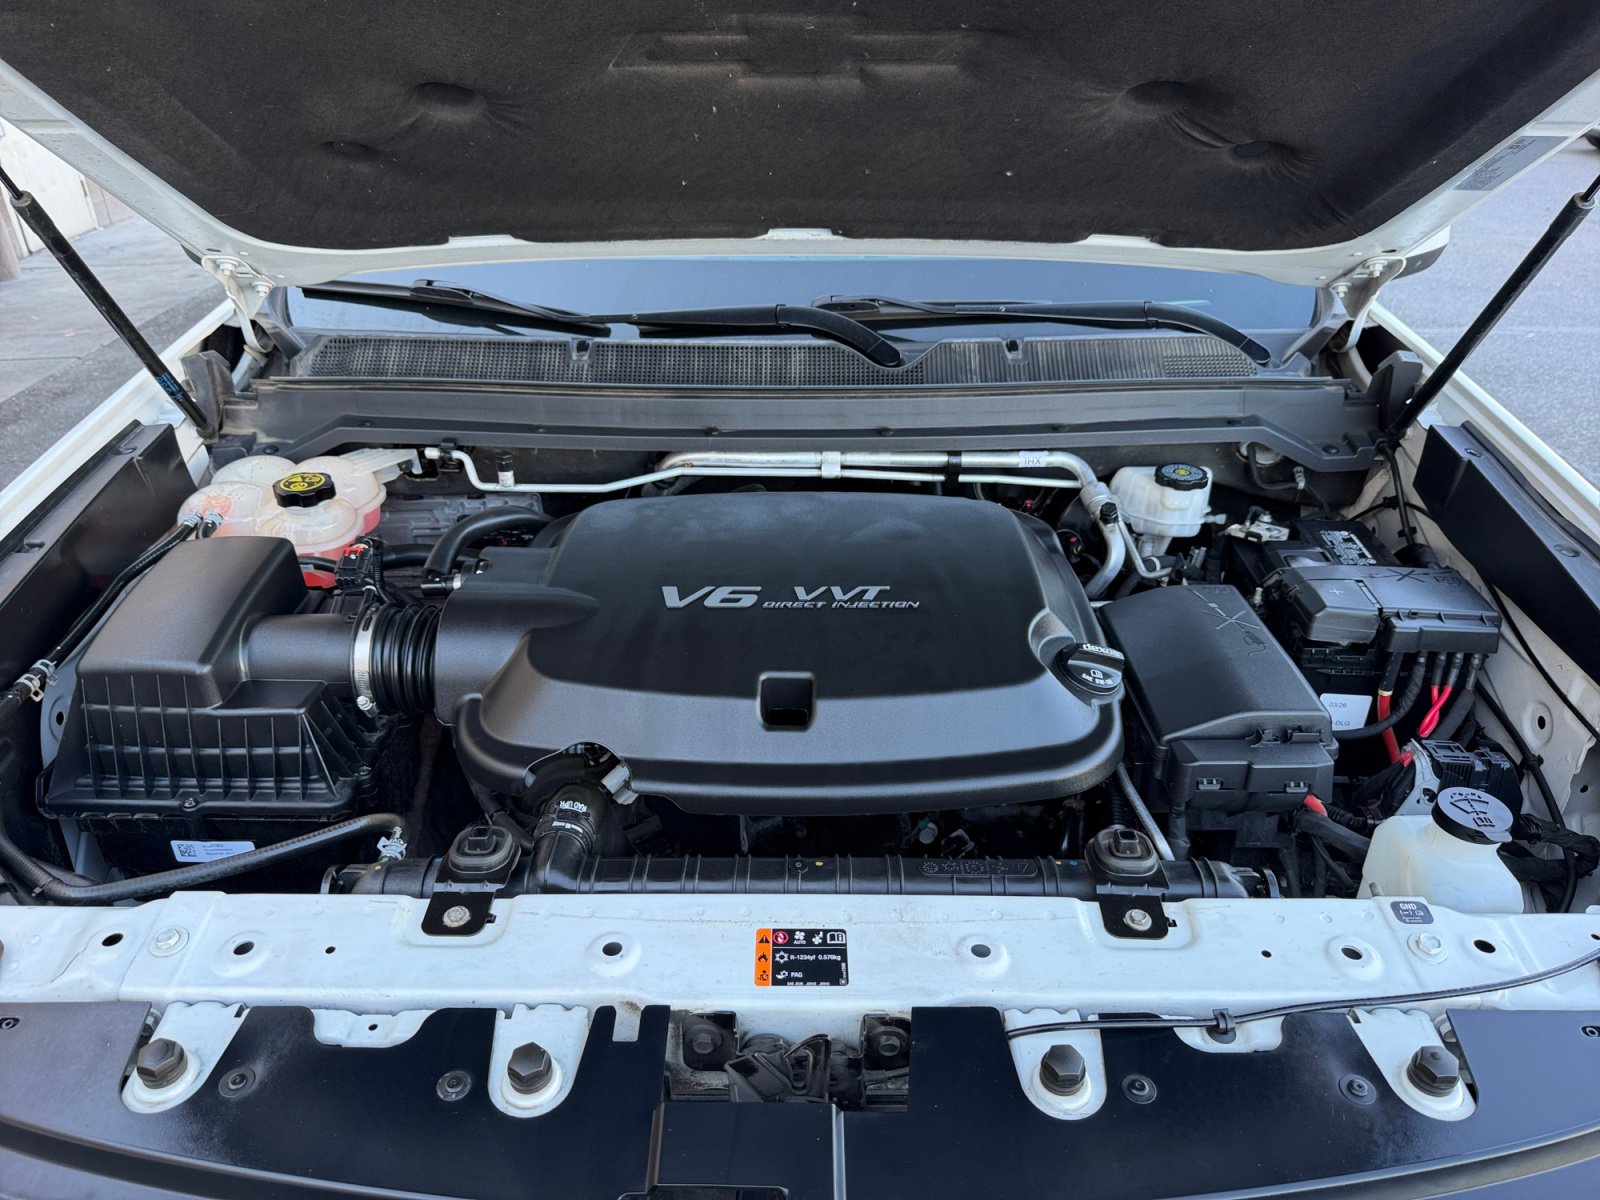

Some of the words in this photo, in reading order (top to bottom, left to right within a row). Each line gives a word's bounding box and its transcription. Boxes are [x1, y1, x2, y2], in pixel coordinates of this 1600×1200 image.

[661, 585, 762, 608] V6
[793, 585, 891, 601] VVT
[762, 601, 827, 609] DIRECT
[831, 601, 920, 609] INJECTION
[559, 800, 573, 810] UPR
[574, 802, 587, 812] RAD
[1399, 902, 1417, 910] GND
[789, 954, 816, 962] R-1234yf
